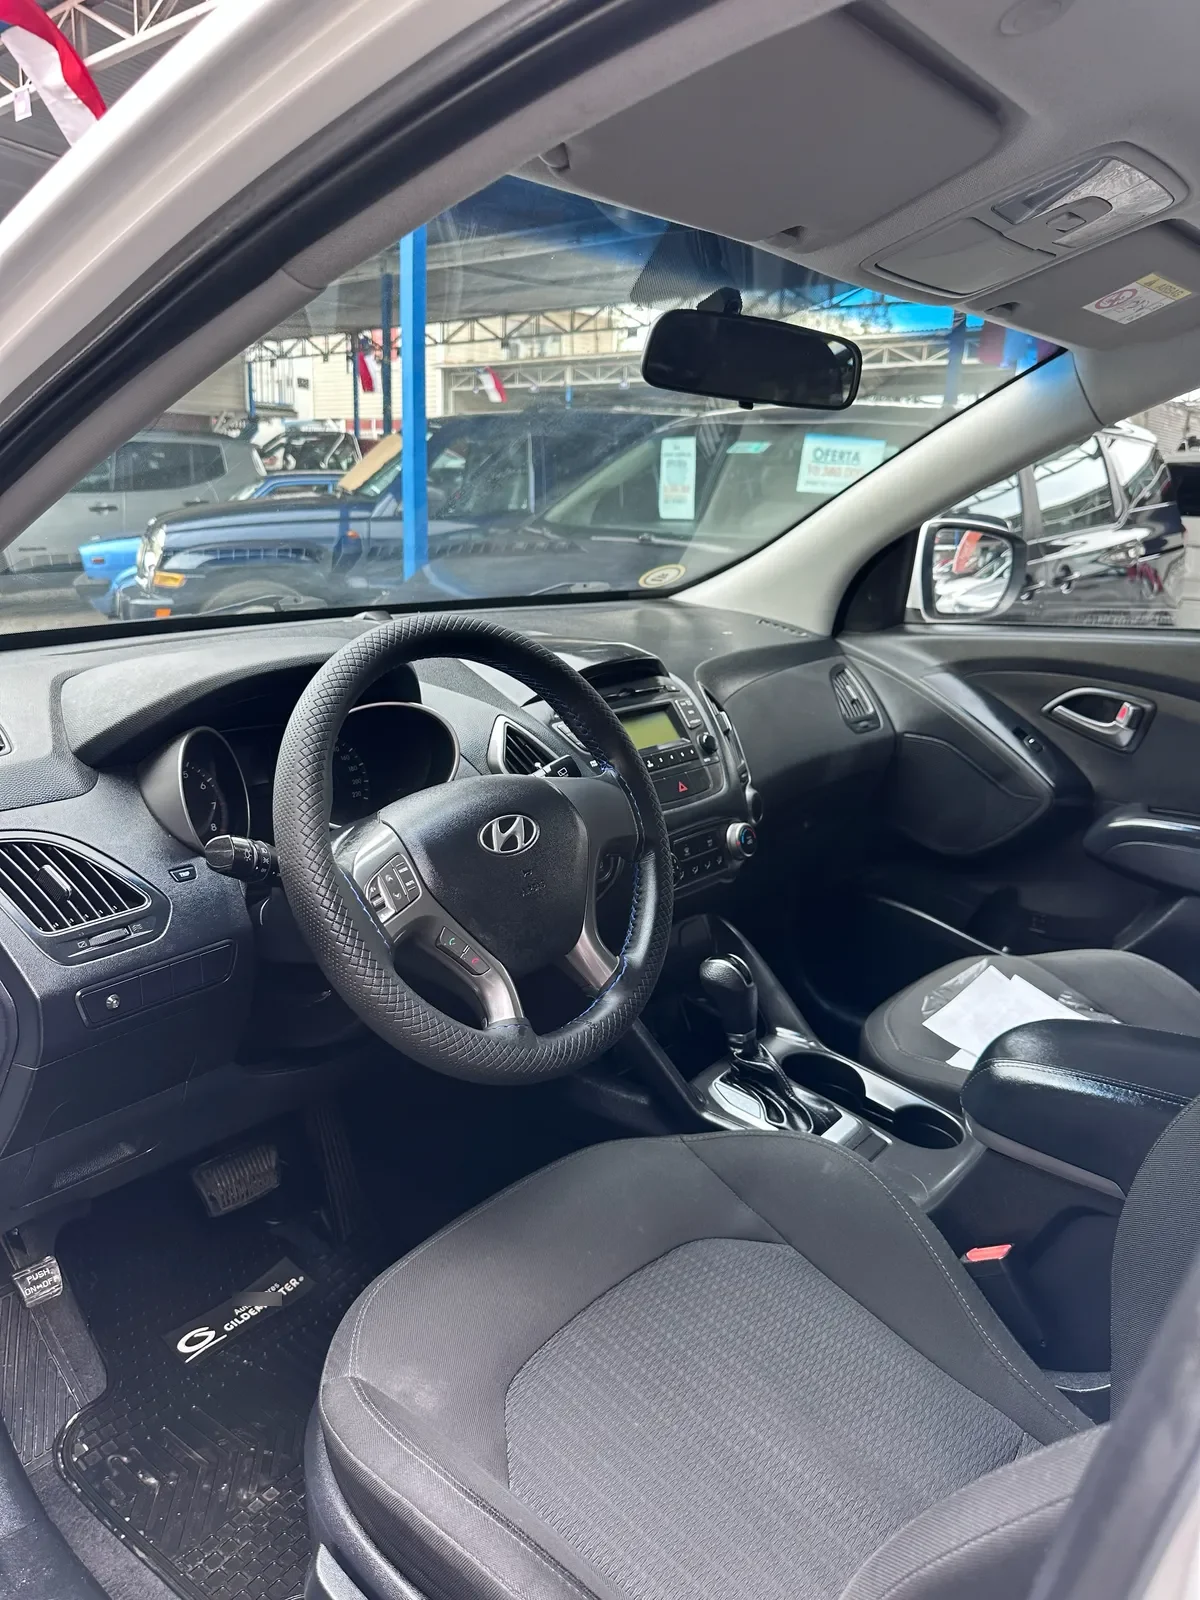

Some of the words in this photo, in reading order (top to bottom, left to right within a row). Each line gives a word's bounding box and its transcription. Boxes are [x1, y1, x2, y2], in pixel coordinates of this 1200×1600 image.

[812, 447, 860, 465] OFERTA
[200, 782, 207, 790] 6
[210, 801, 217, 810] 7
[210, 823, 217, 832] 8
[26, 1267, 50, 1285] PUSH
